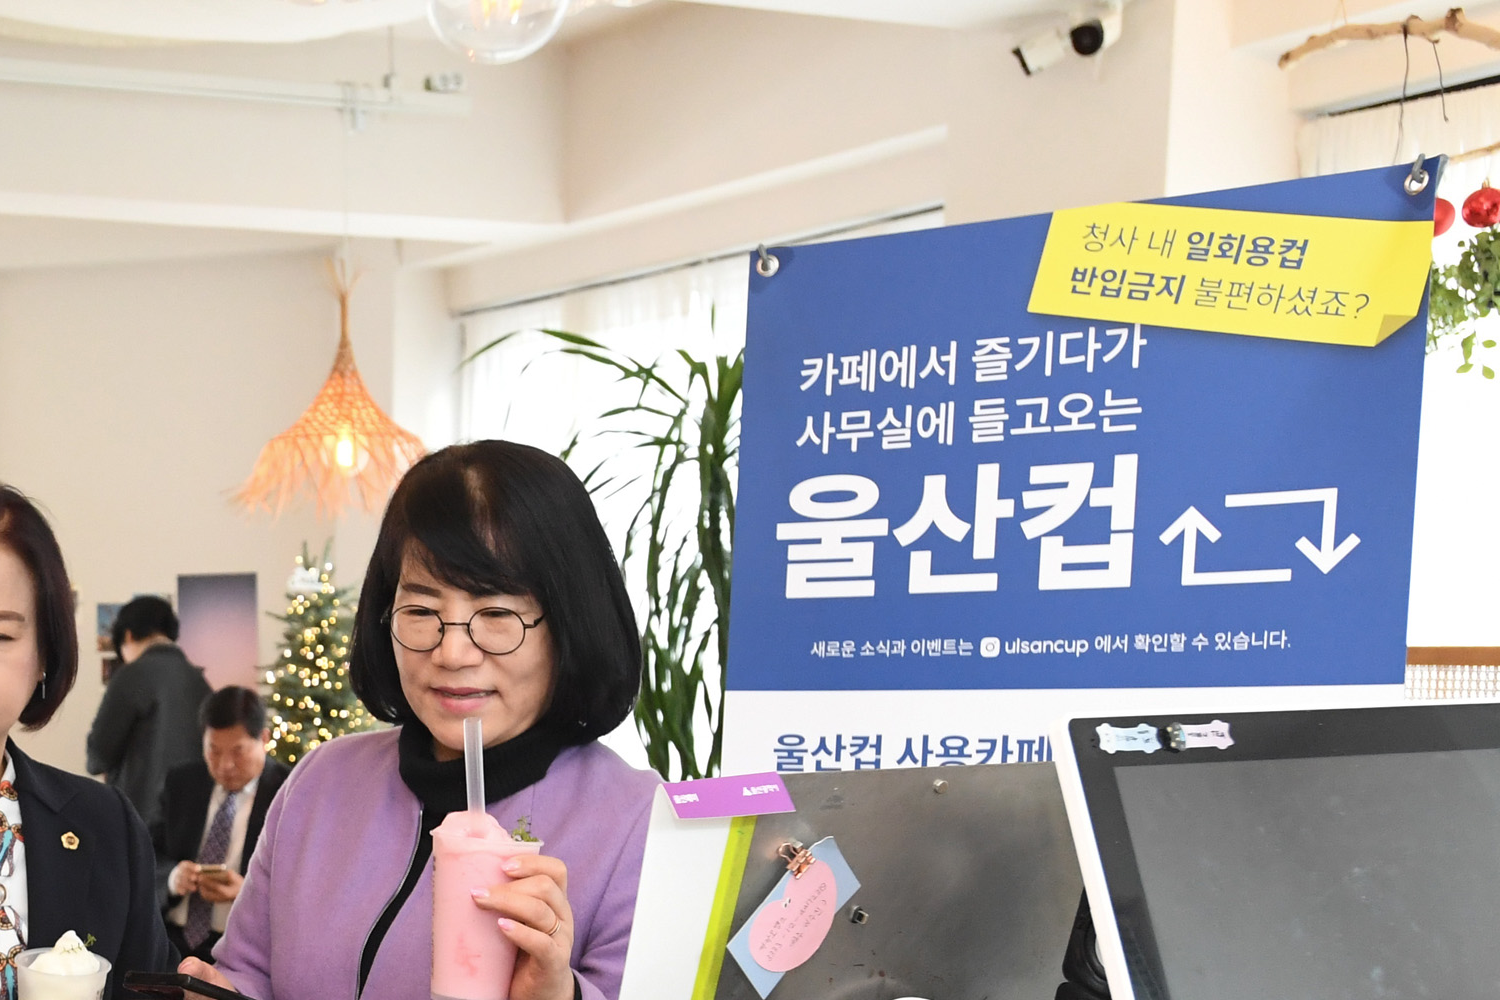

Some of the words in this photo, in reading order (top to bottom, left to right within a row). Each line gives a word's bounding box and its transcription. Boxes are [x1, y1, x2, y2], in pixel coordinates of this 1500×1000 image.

[1082, 222, 1139, 255] 청사
[1147, 229, 1177, 259] 내
[1186, 231, 1309, 270] 일회용컵
[1070, 266, 1186, 305] 반입금지
[1194, 277, 1370, 319] 불편하셨죠?
[800, 340, 958, 396] 카페에서
[971, 323, 1148, 383] 즐기다가
[795, 400, 955, 455] 사무실에
[968, 389, 1143, 444] 들고오는
[775, 453, 1139, 600] 울산컵
[810, 640, 856, 658] 새로운
[860, 639, 906, 658] 소식과
[911, 638, 973, 657] 이벤트는
[1005, 637, 1089, 657] ulsancup
[1095, 634, 1128, 654] 에서
[1134, 633, 1186, 653] 확인할
[1192, 632, 1209, 652] 수
[1215, 630, 1291, 651] 있습니다.
[773, 734, 883, 772] 울산컵
